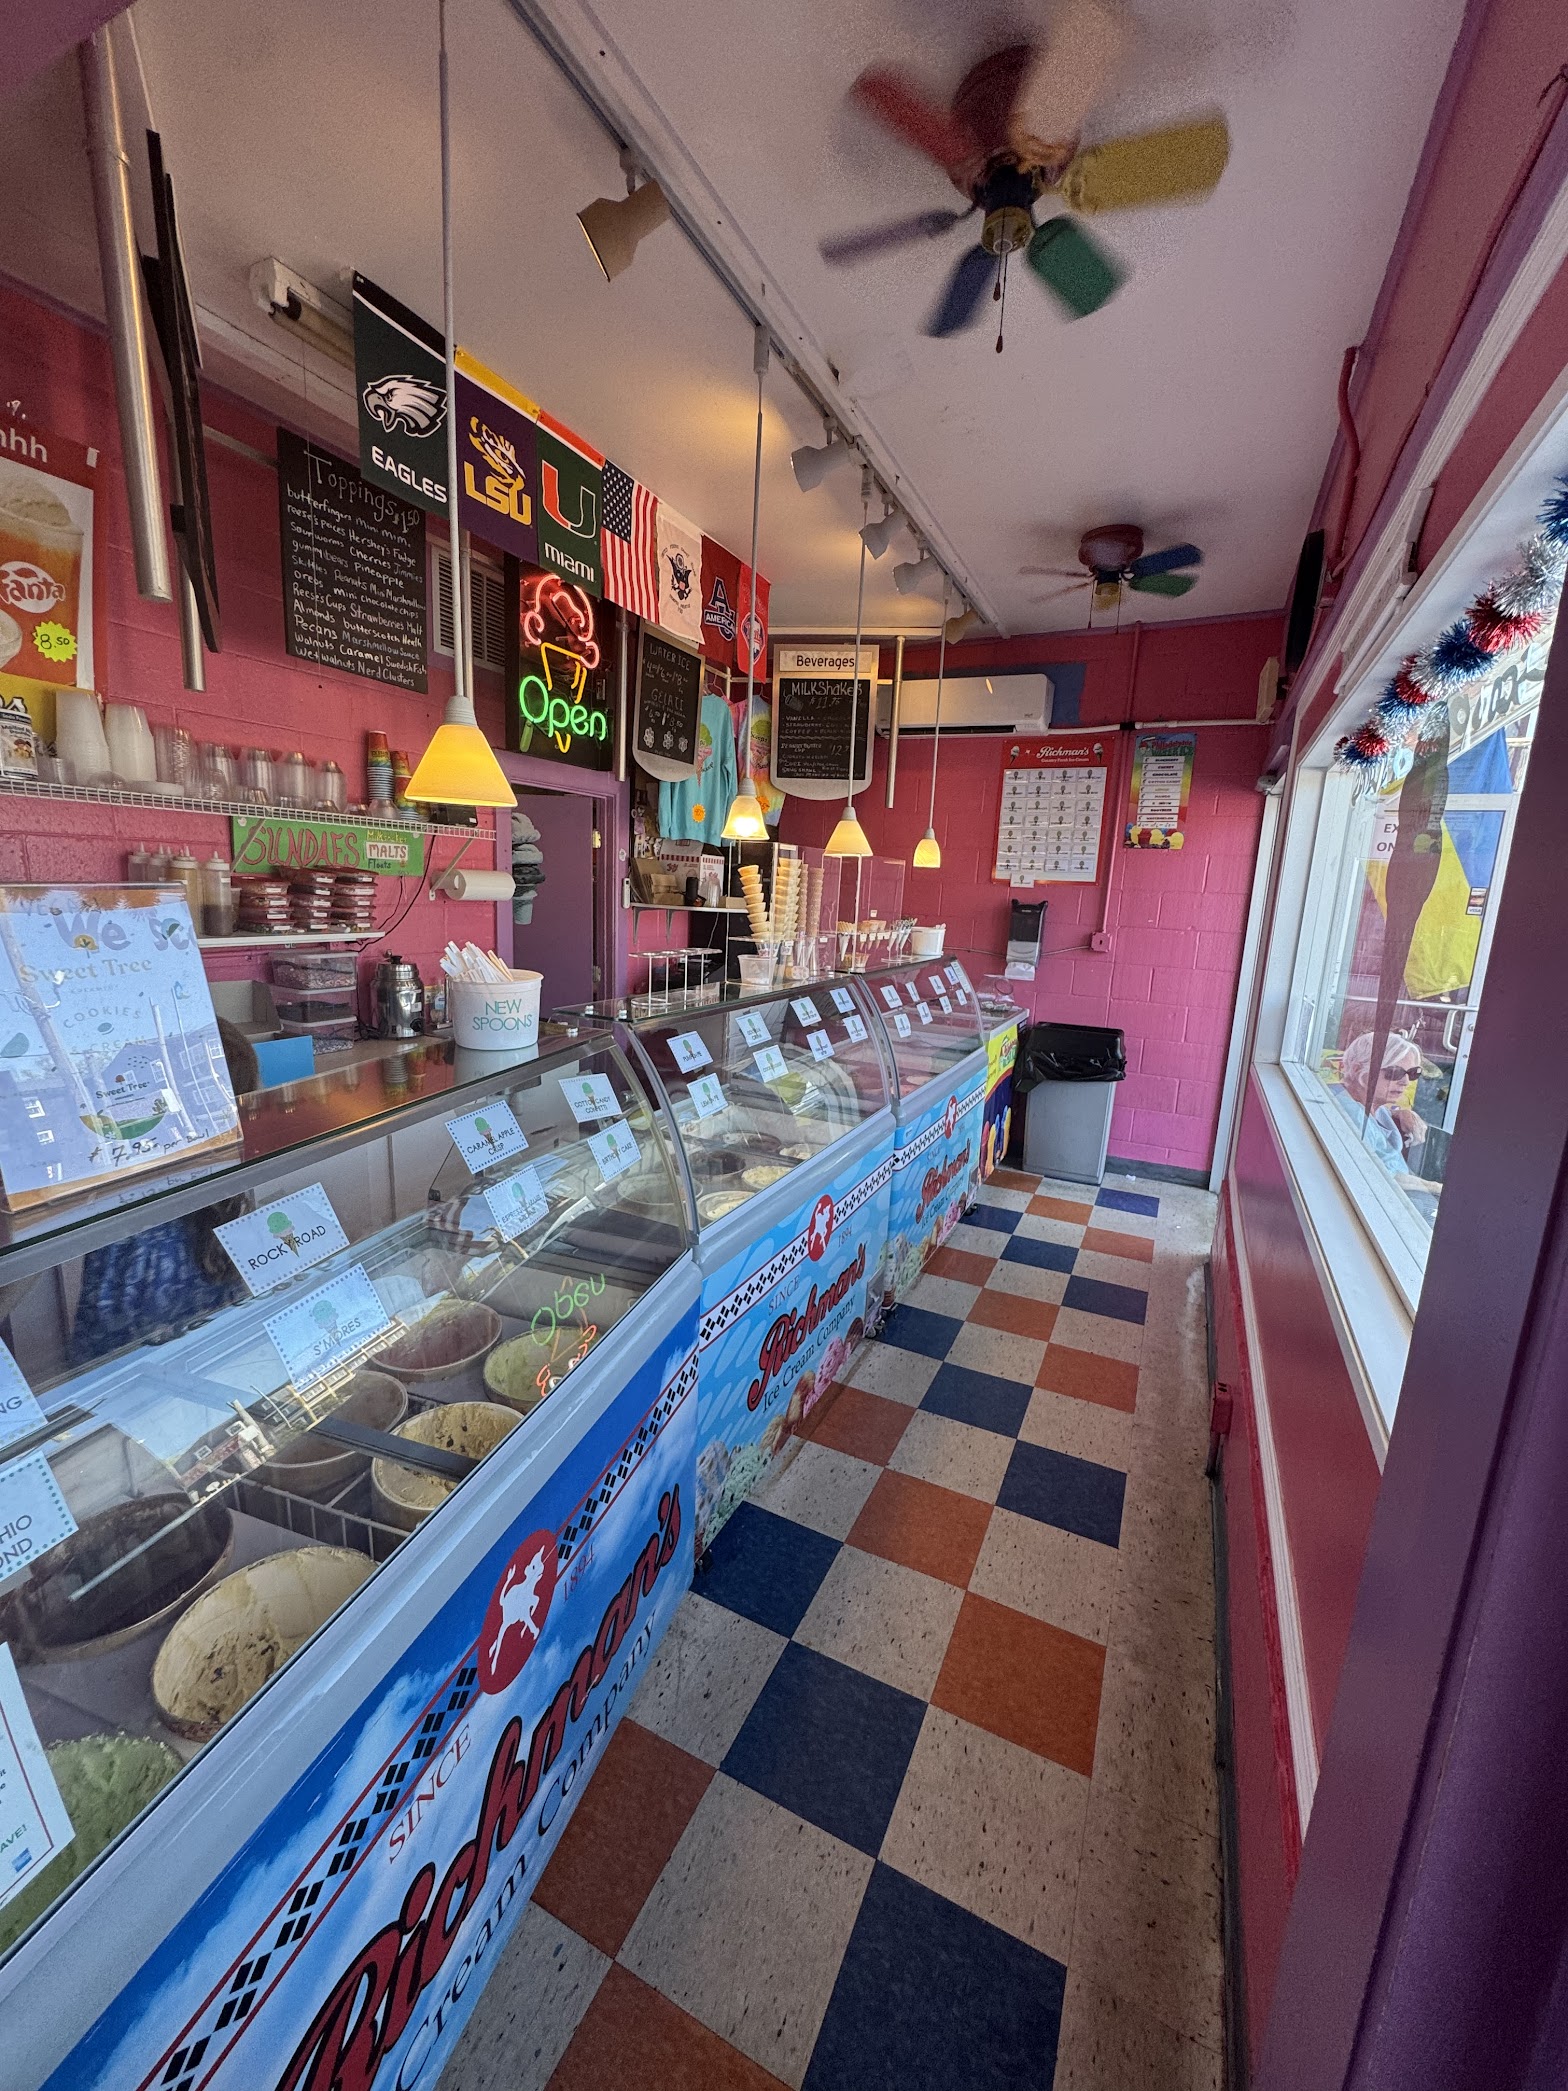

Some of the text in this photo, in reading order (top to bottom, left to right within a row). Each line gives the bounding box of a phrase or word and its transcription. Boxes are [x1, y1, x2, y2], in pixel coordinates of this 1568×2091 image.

[303, 450, 397, 522] Toppings
[371, 446, 447, 504] EAGLES
[463, 460, 532, 526] LSU
[286, 483, 352, 523] butterfingers
[541, 459, 597, 539] U
[314, 534, 344, 548] worms
[350, 545, 391, 569] Cherries
[393, 562, 423, 584] Jimmies
[349, 528, 391, 557] Hershey's
[393, 548, 417, 569] Fudge
[291, 554, 328, 576] Skittles
[334, 569, 367, 591] Peanuts
[354, 562, 405, 589] Pineapple
[292, 581, 424, 636] Reese's Cups Strawberries Malt
[293, 599, 423, 648] Almonds butterscotch Heath
[361, 594, 401, 613] chocolate
[399, 608, 419, 619] chips
[40, 633, 70, 650] 8.50
[294, 614, 338, 640] Pecans
[399, 647, 420, 661] Sauce
[294, 631, 427, 675] Walnuts Caramel Swedish Fish
[649, 642, 677, 665] WATER
[677, 654, 690, 672] ICE
[295, 645, 415, 688] Wet walnuts Nerd Clusters
[796, 655, 855, 671] Beverages
[519, 675, 607, 741] Open
[1036, 746, 1090, 759] Richman's
[242, 825, 360, 869] SUNDAES
[367, 858, 392, 870] Floats
[368, 844, 407, 859] MALTS
[19, 957, 152, 984] Sweet Tree
[63, 1006, 141, 1029] COOKIES
[472, 1013, 533, 1032] SPOONS
[485, 998, 522, 1015] NEW
[95, 1081, 149, 1099] Sweet Tree
[595, 1096, 611, 1104] CANDY
[163, 1139, 183, 1154] per
[498, 1127, 516, 1142] APPLE
[621, 1141, 633, 1153] CAKE
[247, 1224, 327, 1271] ROCKY ROAD
[767, 1273, 801, 1317] SINCE
[313, 1317, 362, 1356] S'MORES
[746, 1241, 868, 1412] Richman's
[762, 1293, 856, 1415] Ice Cream Company
[388, 1546, 596, 1865] SINCE 1894
[279, 1483, 682, 2091] Richman's
[397, 1608, 658, 2091] Cream Company
